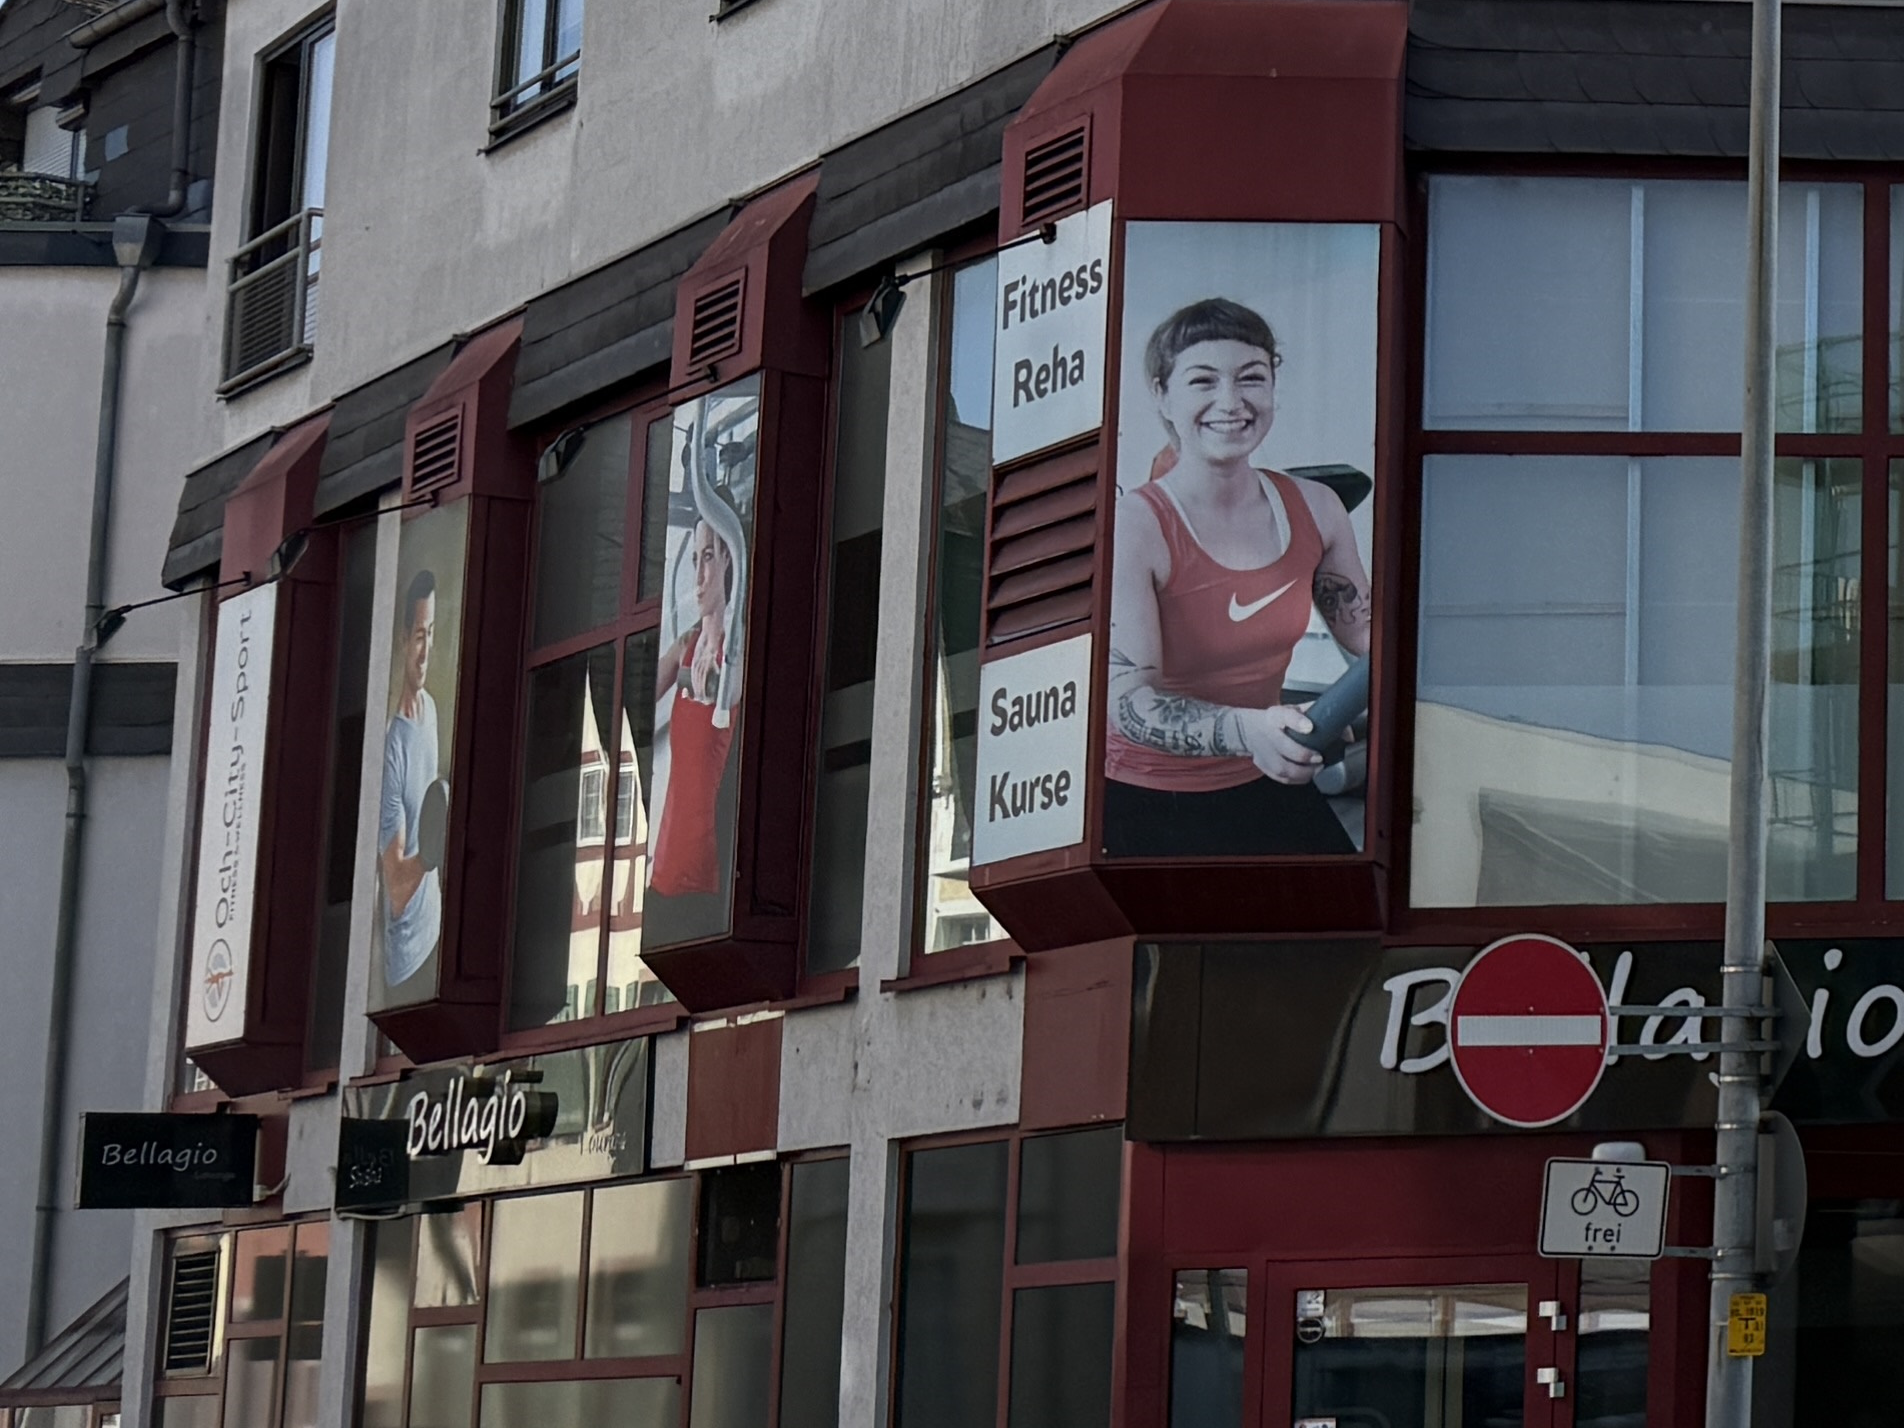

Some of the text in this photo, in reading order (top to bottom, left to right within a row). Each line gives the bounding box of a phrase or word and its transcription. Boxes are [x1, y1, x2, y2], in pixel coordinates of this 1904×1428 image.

[1002, 258, 1103, 330] Fitness
[1013, 343, 1085, 408] Reha
[990, 680, 1077, 736] Sauna
[988, 769, 1071, 822] Kurse
[407, 1069, 527, 1164] Bellagio
[101, 1141, 218, 1172] Bellagio
[1584, 1222, 1622, 1243] frei
